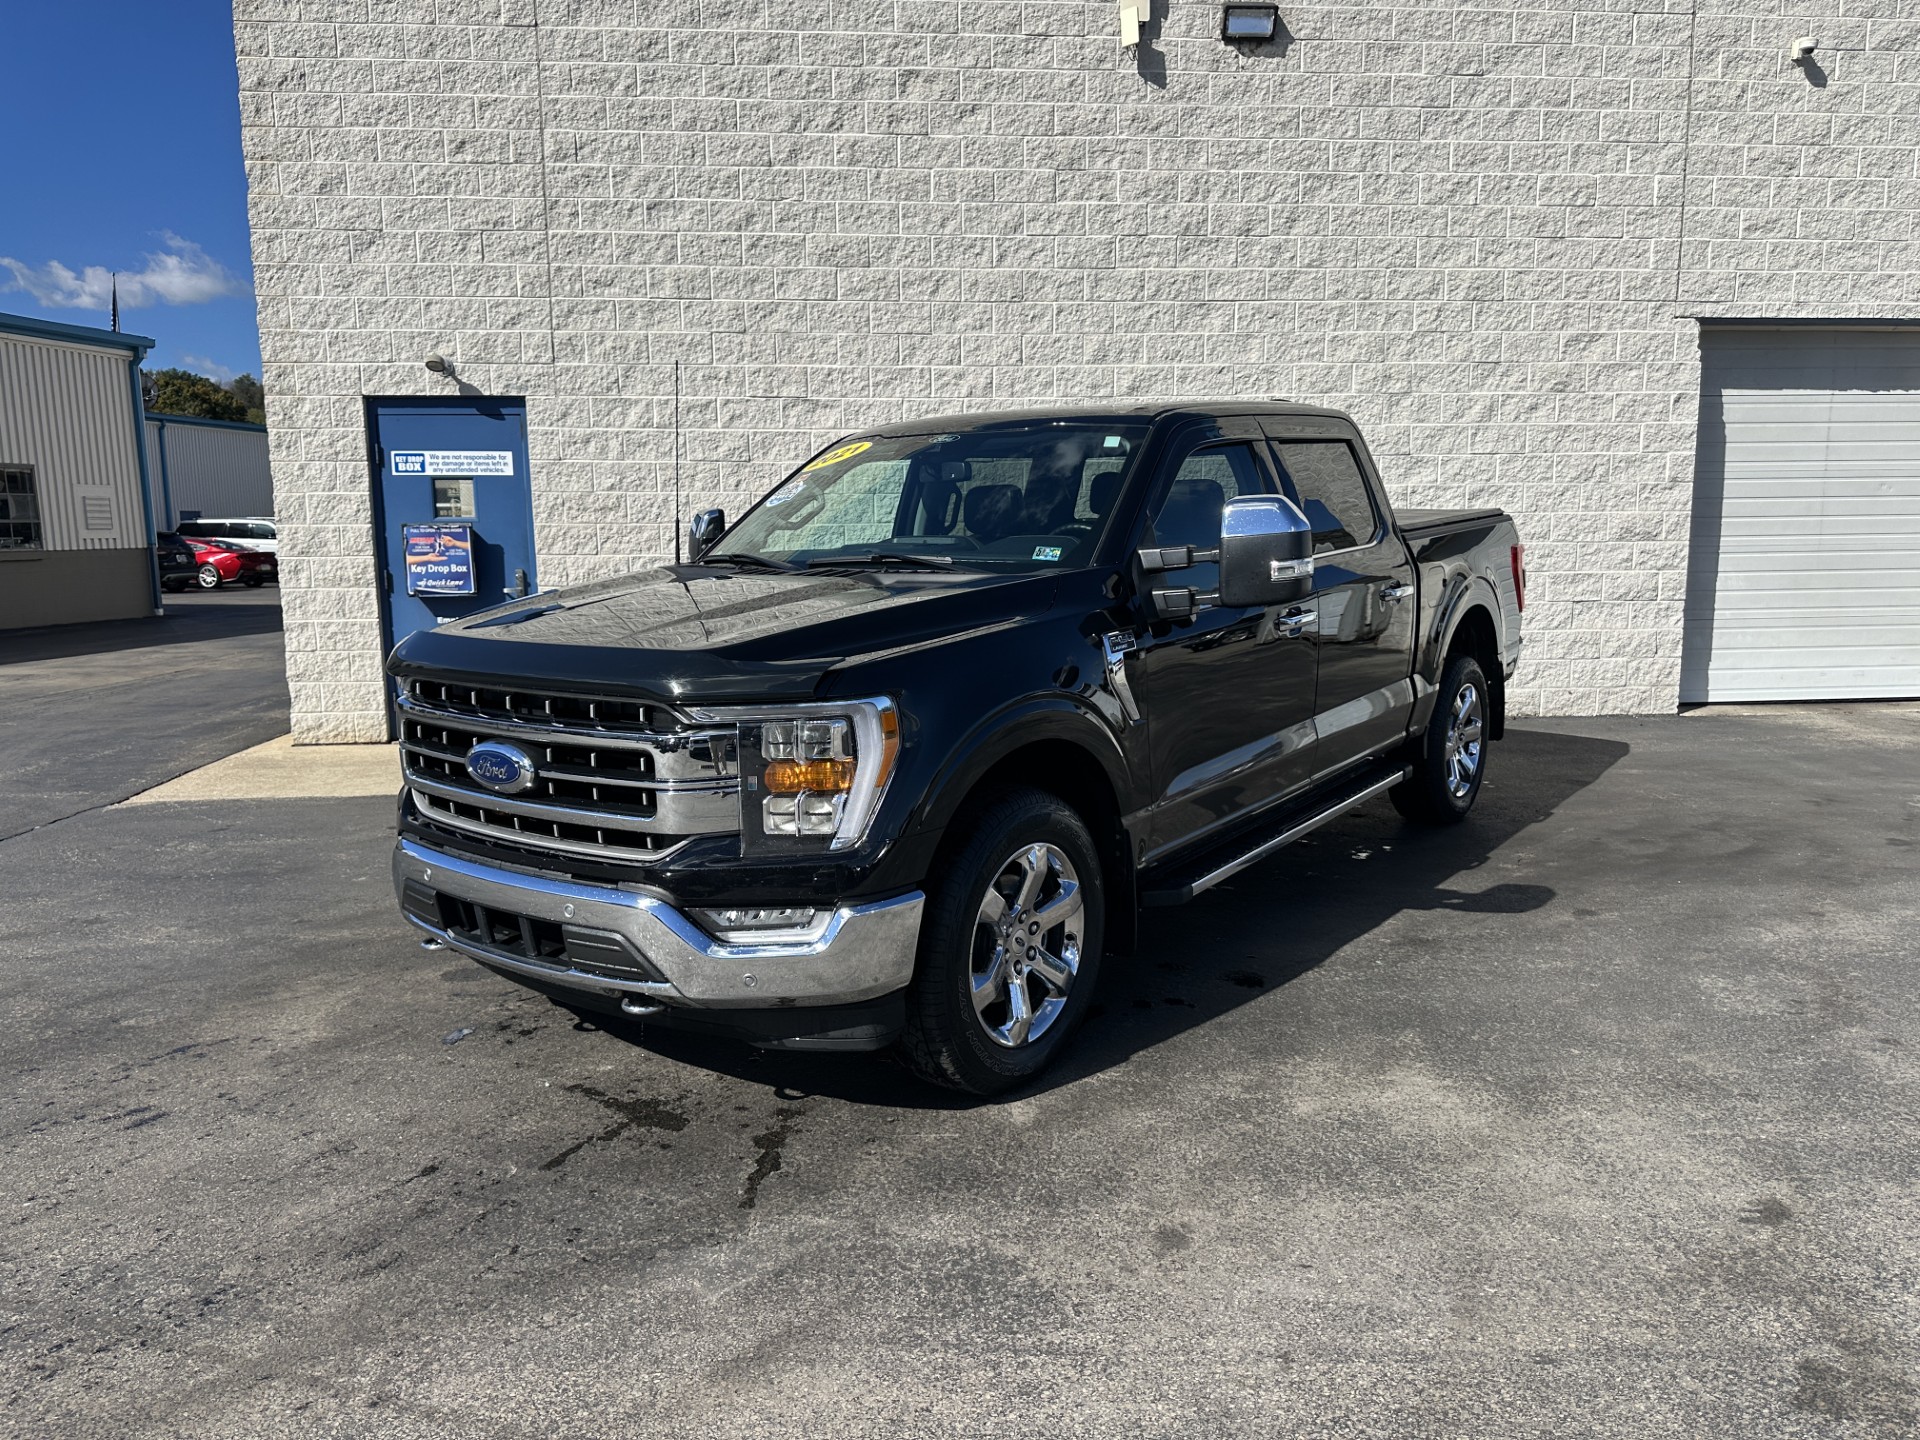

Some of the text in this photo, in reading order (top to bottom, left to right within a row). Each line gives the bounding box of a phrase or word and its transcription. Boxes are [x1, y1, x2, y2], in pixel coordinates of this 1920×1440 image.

[398, 462, 422, 471] BOX
[411, 564, 468, 574] Key Drop Box
[477, 755, 508, 779] Ford
